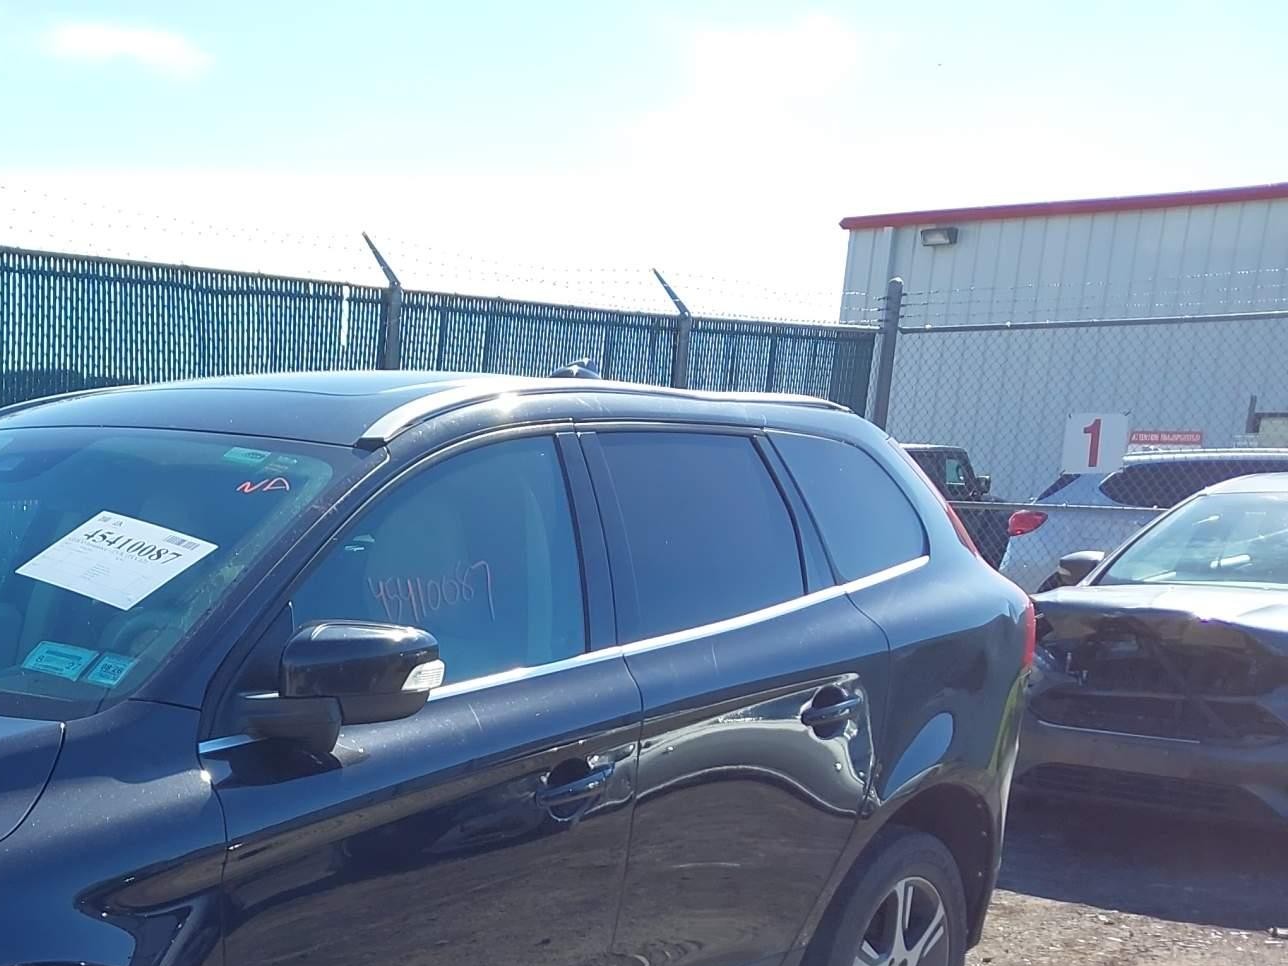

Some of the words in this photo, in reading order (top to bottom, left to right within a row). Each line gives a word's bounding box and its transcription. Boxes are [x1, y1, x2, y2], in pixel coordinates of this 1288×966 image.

[1083, 418, 1102, 468] 1
[83, 528, 183, 564] 45410087
[367, 560, 496, 623] 45410087
